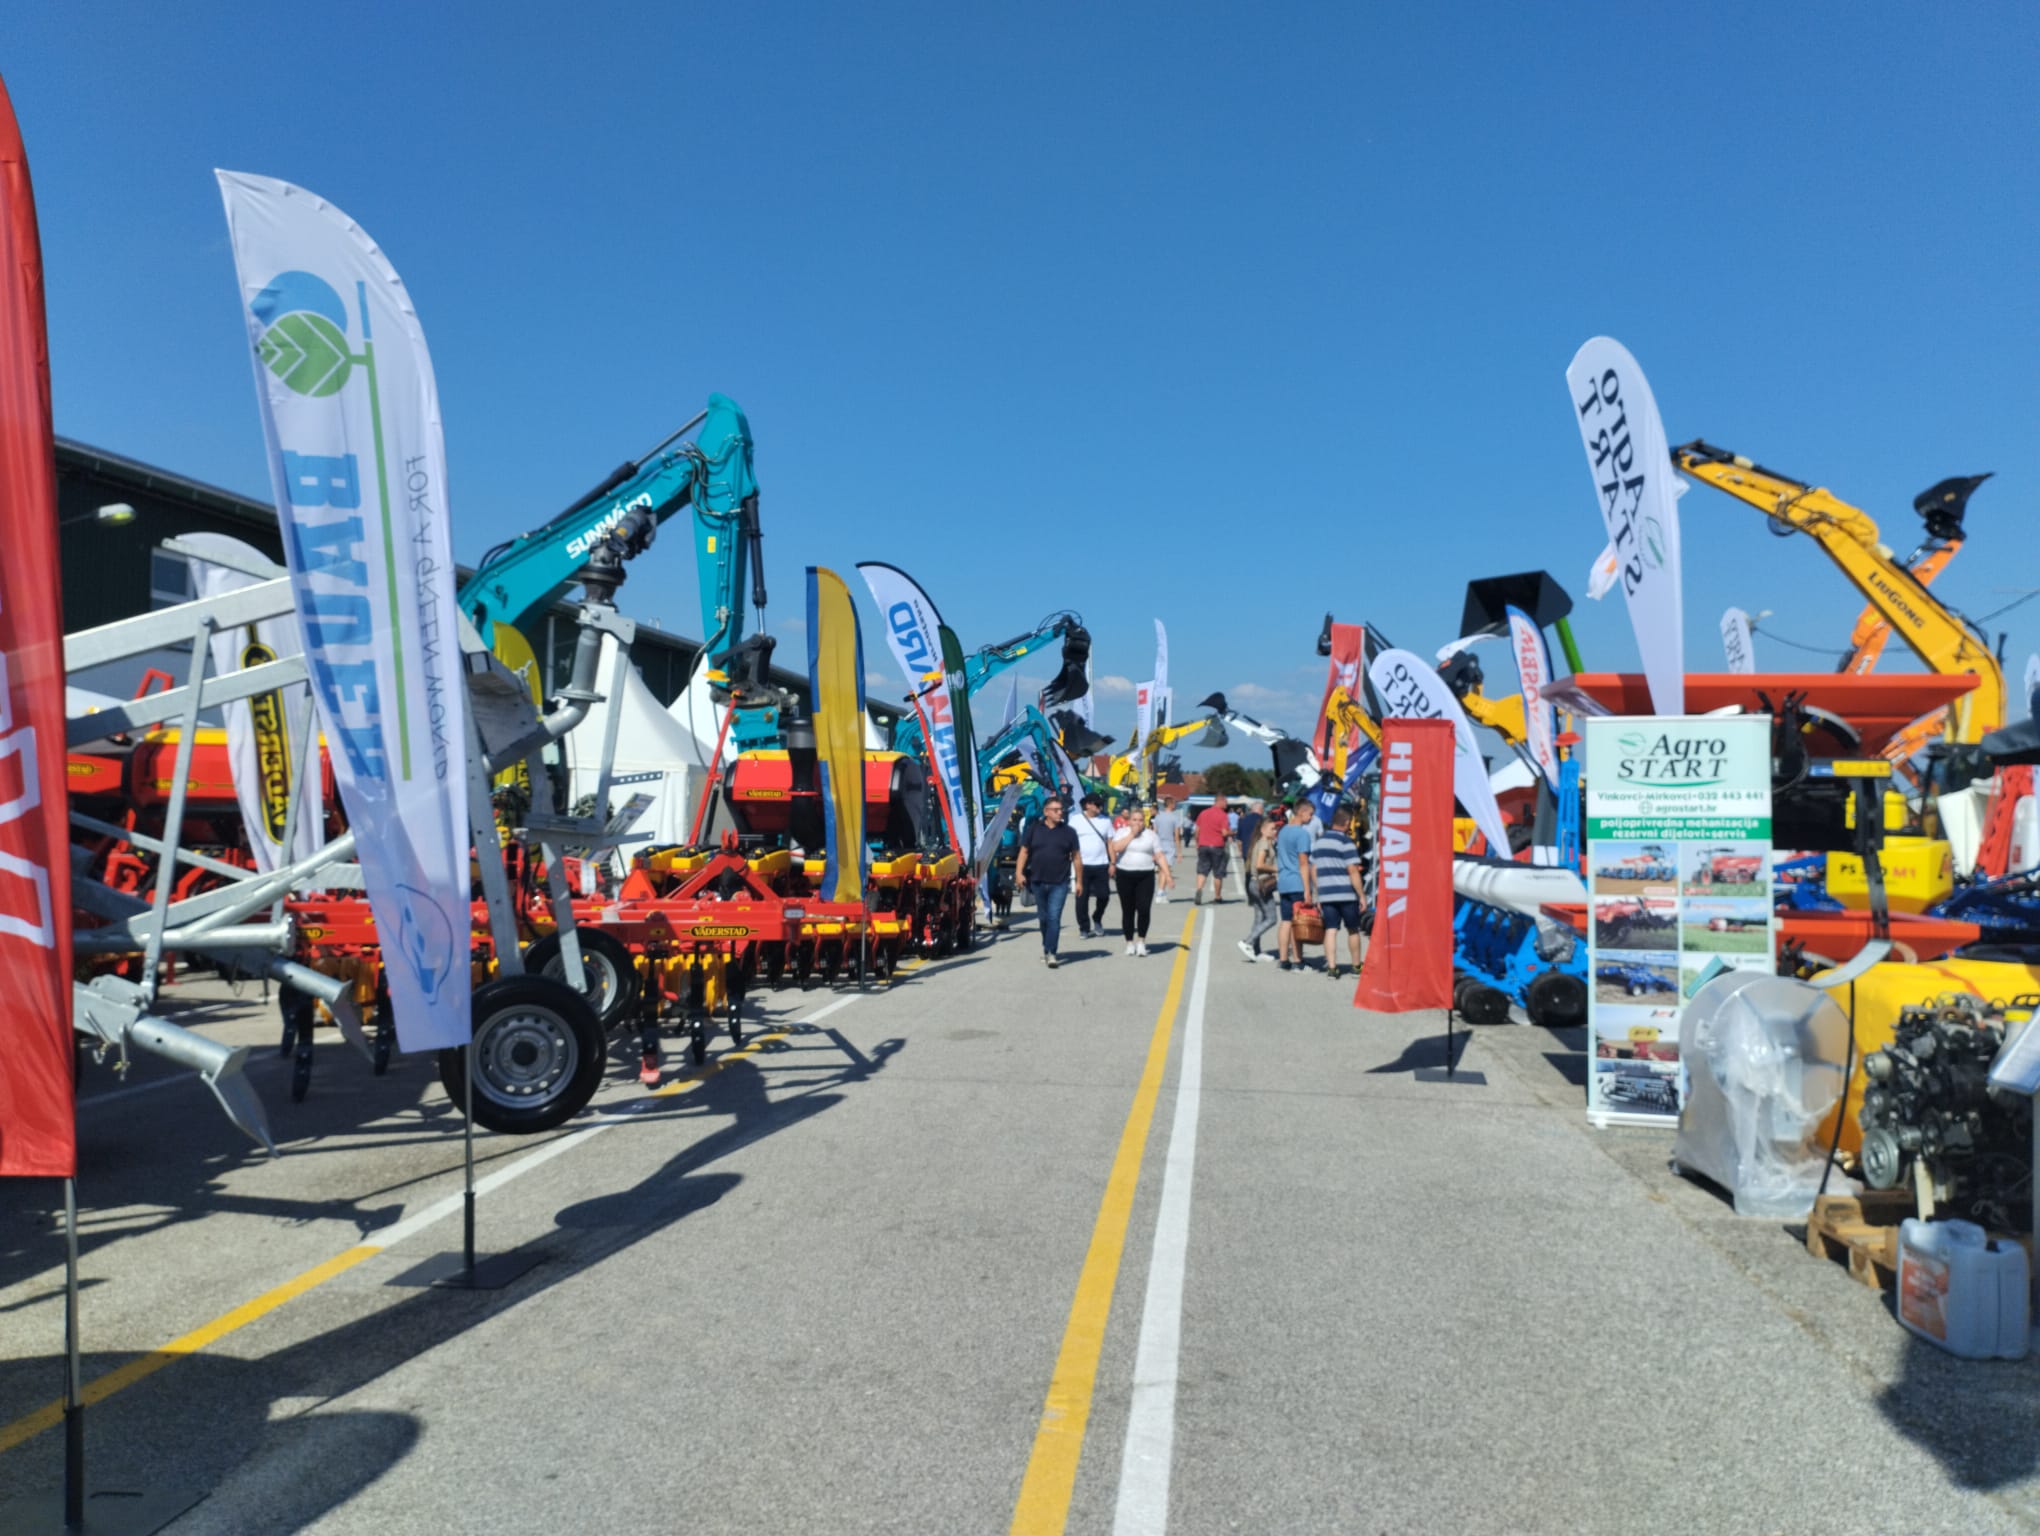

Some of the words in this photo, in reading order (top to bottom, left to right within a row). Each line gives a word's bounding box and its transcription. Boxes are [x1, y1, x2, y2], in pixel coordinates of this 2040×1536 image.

[1649, 733, 1727, 762] Agro
[1617, 758, 1728, 779] START
[1600, 817, 1684, 830] poljoprivredna
[1686, 817, 1759, 830] mehanizacija
[694, 925, 747, 936] VÄDERSTAD
